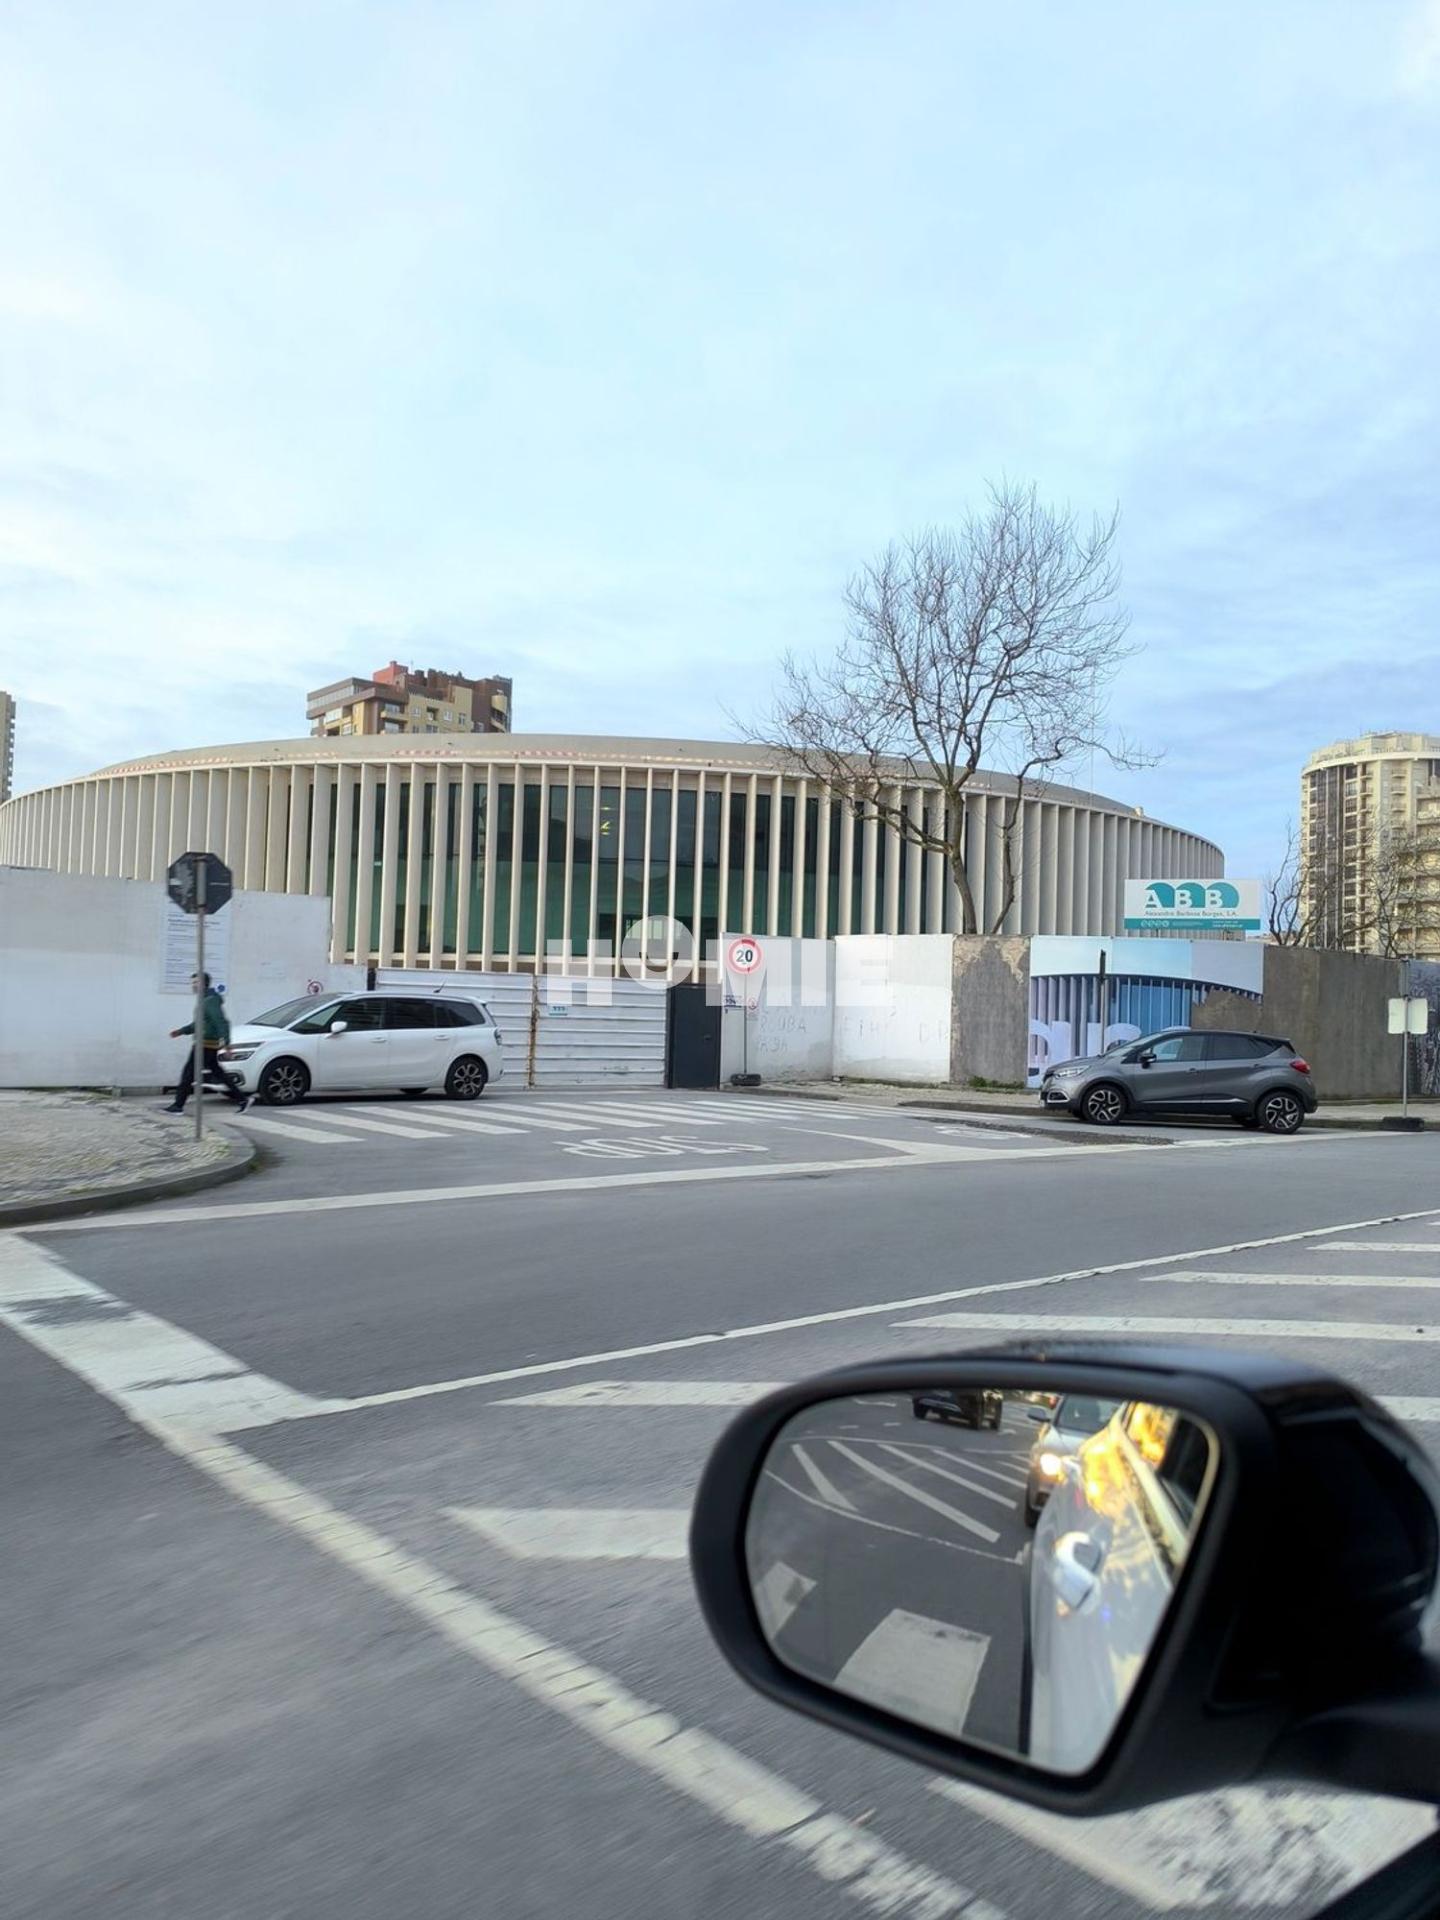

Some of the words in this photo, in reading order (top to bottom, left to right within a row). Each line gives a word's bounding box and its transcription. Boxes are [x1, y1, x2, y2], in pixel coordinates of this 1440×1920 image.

[1144, 883, 1239, 908] ABB
[736, 950, 753, 962] 20
[552, 1135, 769, 1158] STOP
